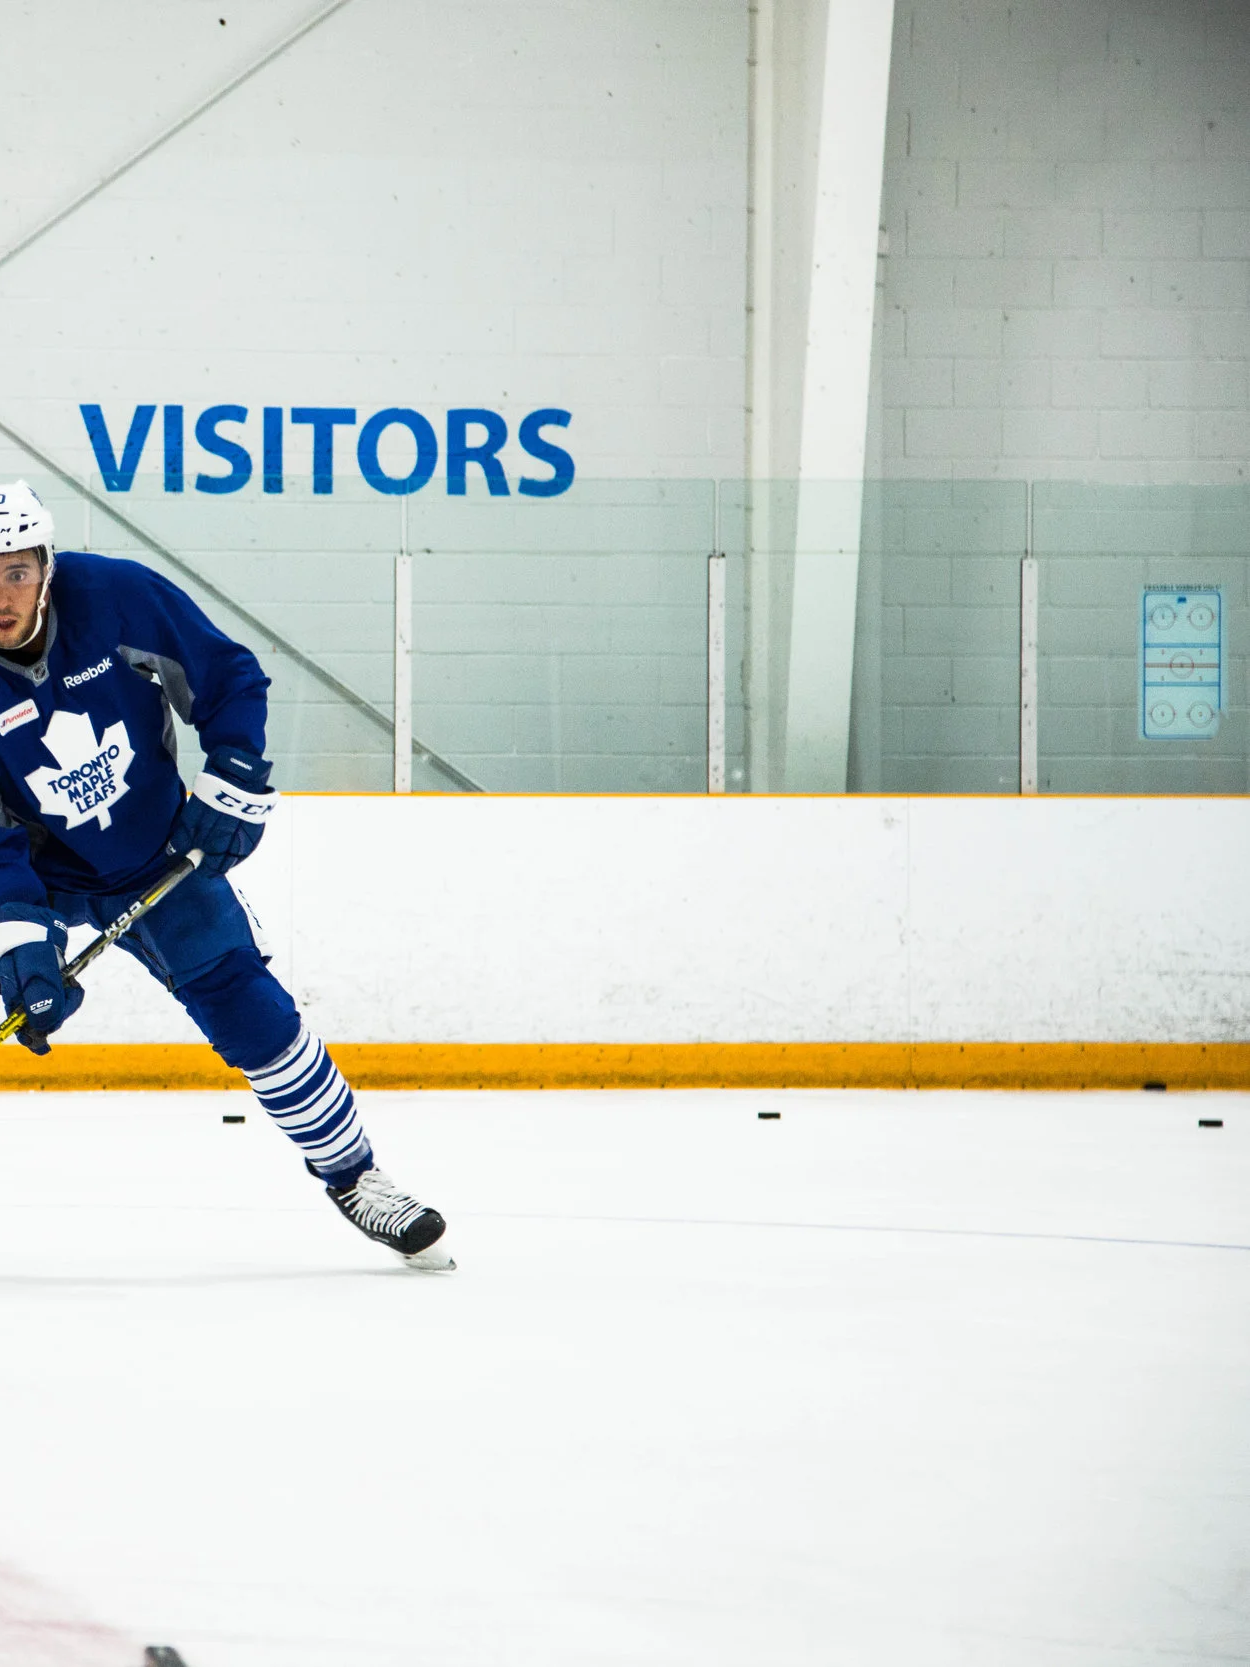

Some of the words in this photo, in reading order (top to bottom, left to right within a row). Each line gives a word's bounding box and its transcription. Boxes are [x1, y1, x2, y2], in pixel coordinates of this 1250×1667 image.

[78, 403, 576, 498] VISITORS
[62, 657, 114, 689] Reebok
[47, 744, 120, 794] TORONTO
[67, 765, 115, 803] MAPLE
[75, 781, 117, 814] LEAFS
[104, 901, 142, 938] CCM
[29, 998, 54, 1011] CCM
